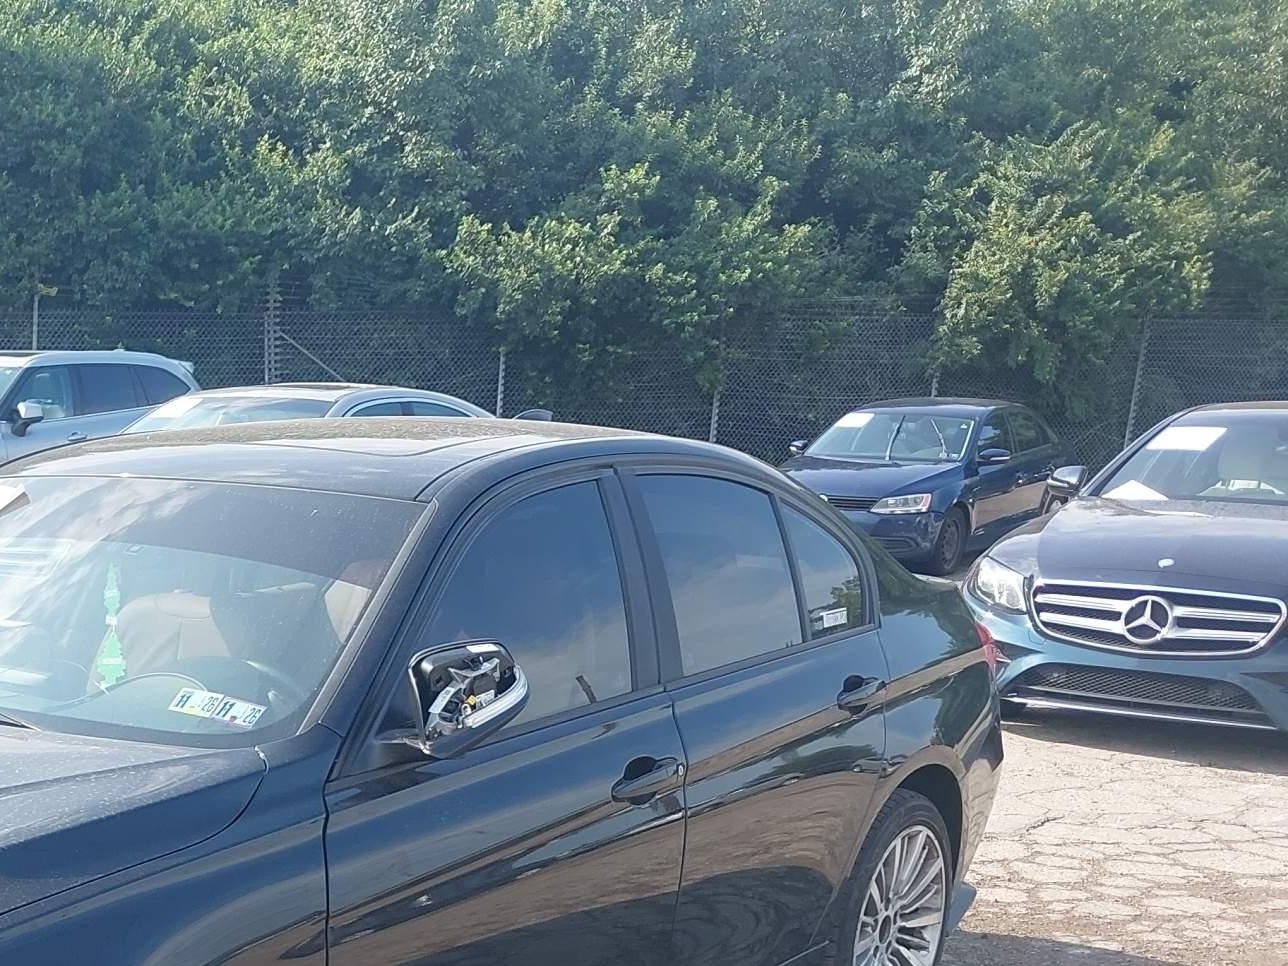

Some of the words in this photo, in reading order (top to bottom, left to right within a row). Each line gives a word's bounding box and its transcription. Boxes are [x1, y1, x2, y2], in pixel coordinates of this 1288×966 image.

[175, 693, 192, 709] 11
[201, 696, 219, 713] 26
[216, 700, 236, 718] 11
[242, 707, 262, 724] 26
